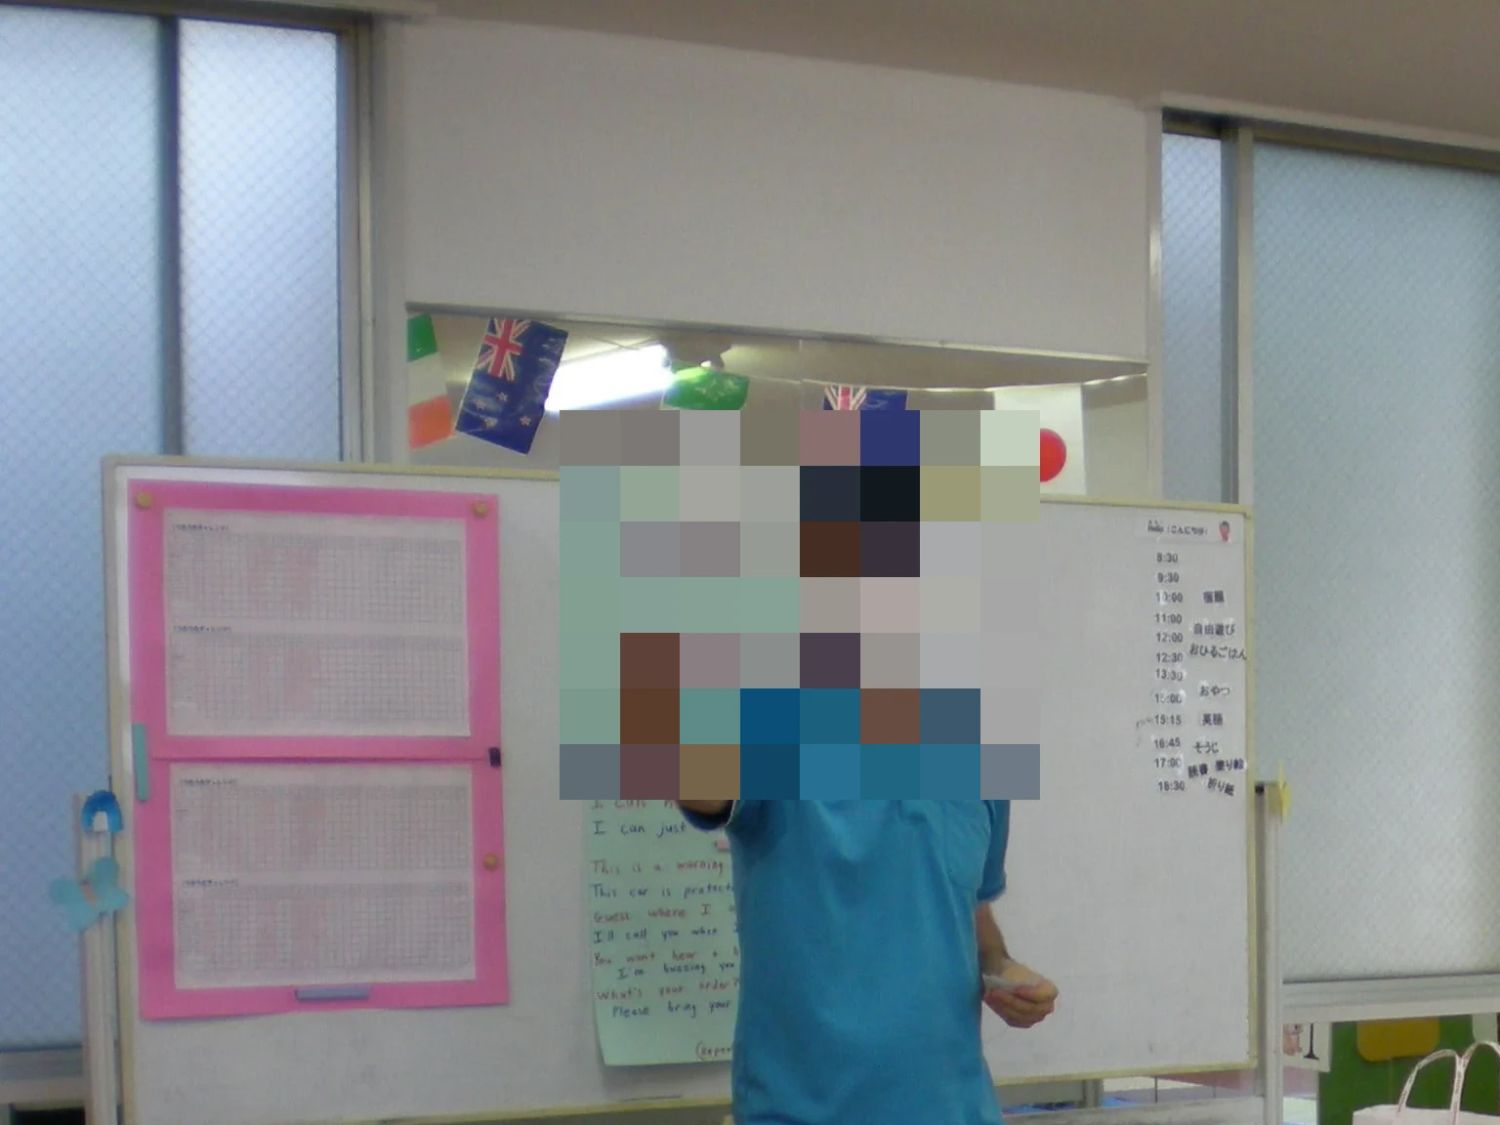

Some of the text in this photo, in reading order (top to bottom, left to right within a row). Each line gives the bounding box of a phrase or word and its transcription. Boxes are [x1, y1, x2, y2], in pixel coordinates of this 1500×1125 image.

[1157, 572, 1180, 583] 9:30
[1156, 592, 1183, 603] 10:00
[1155, 613, 1182, 624] 11:00
[1156, 632, 1183, 643] 12:00
[1156, 652, 1184, 663] 12:30
[1156, 668, 1184, 681] 13:30
[1200, 685, 1231, 697] おやつ
[1154, 714, 1182, 725] 15:15
[1154, 737, 1181, 749] 16:45
[1154, 758, 1181, 768] 17:00
[592, 820, 688, 838] I can just
[590, 859, 620, 875] This
[590, 883, 617, 898] This
[625, 927, 648, 941] call
